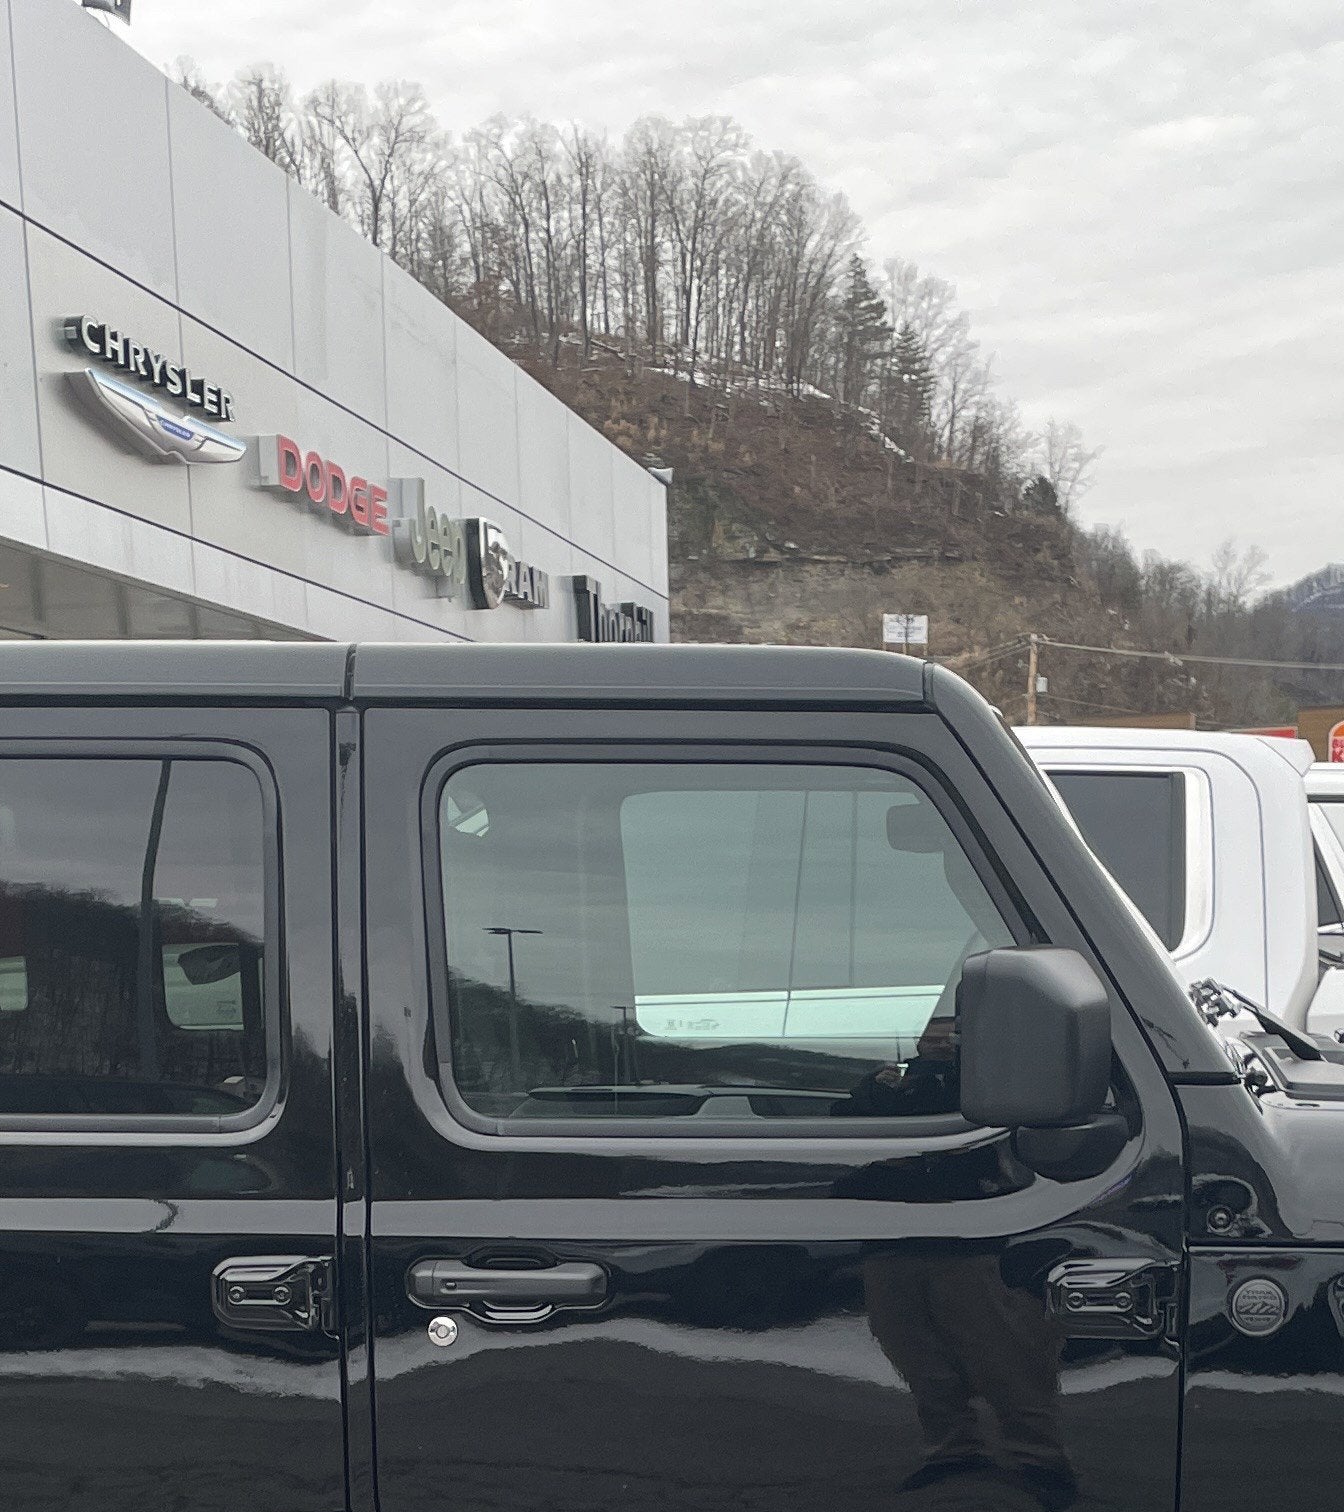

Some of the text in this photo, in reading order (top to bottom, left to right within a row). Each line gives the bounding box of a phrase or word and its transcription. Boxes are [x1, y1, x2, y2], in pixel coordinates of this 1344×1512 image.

[78, 314, 235, 422] CHRYSLER
[274, 434, 391, 536] DODGE
[402, 478, 467, 585] Jeep
[504, 556, 549, 609] RAM
